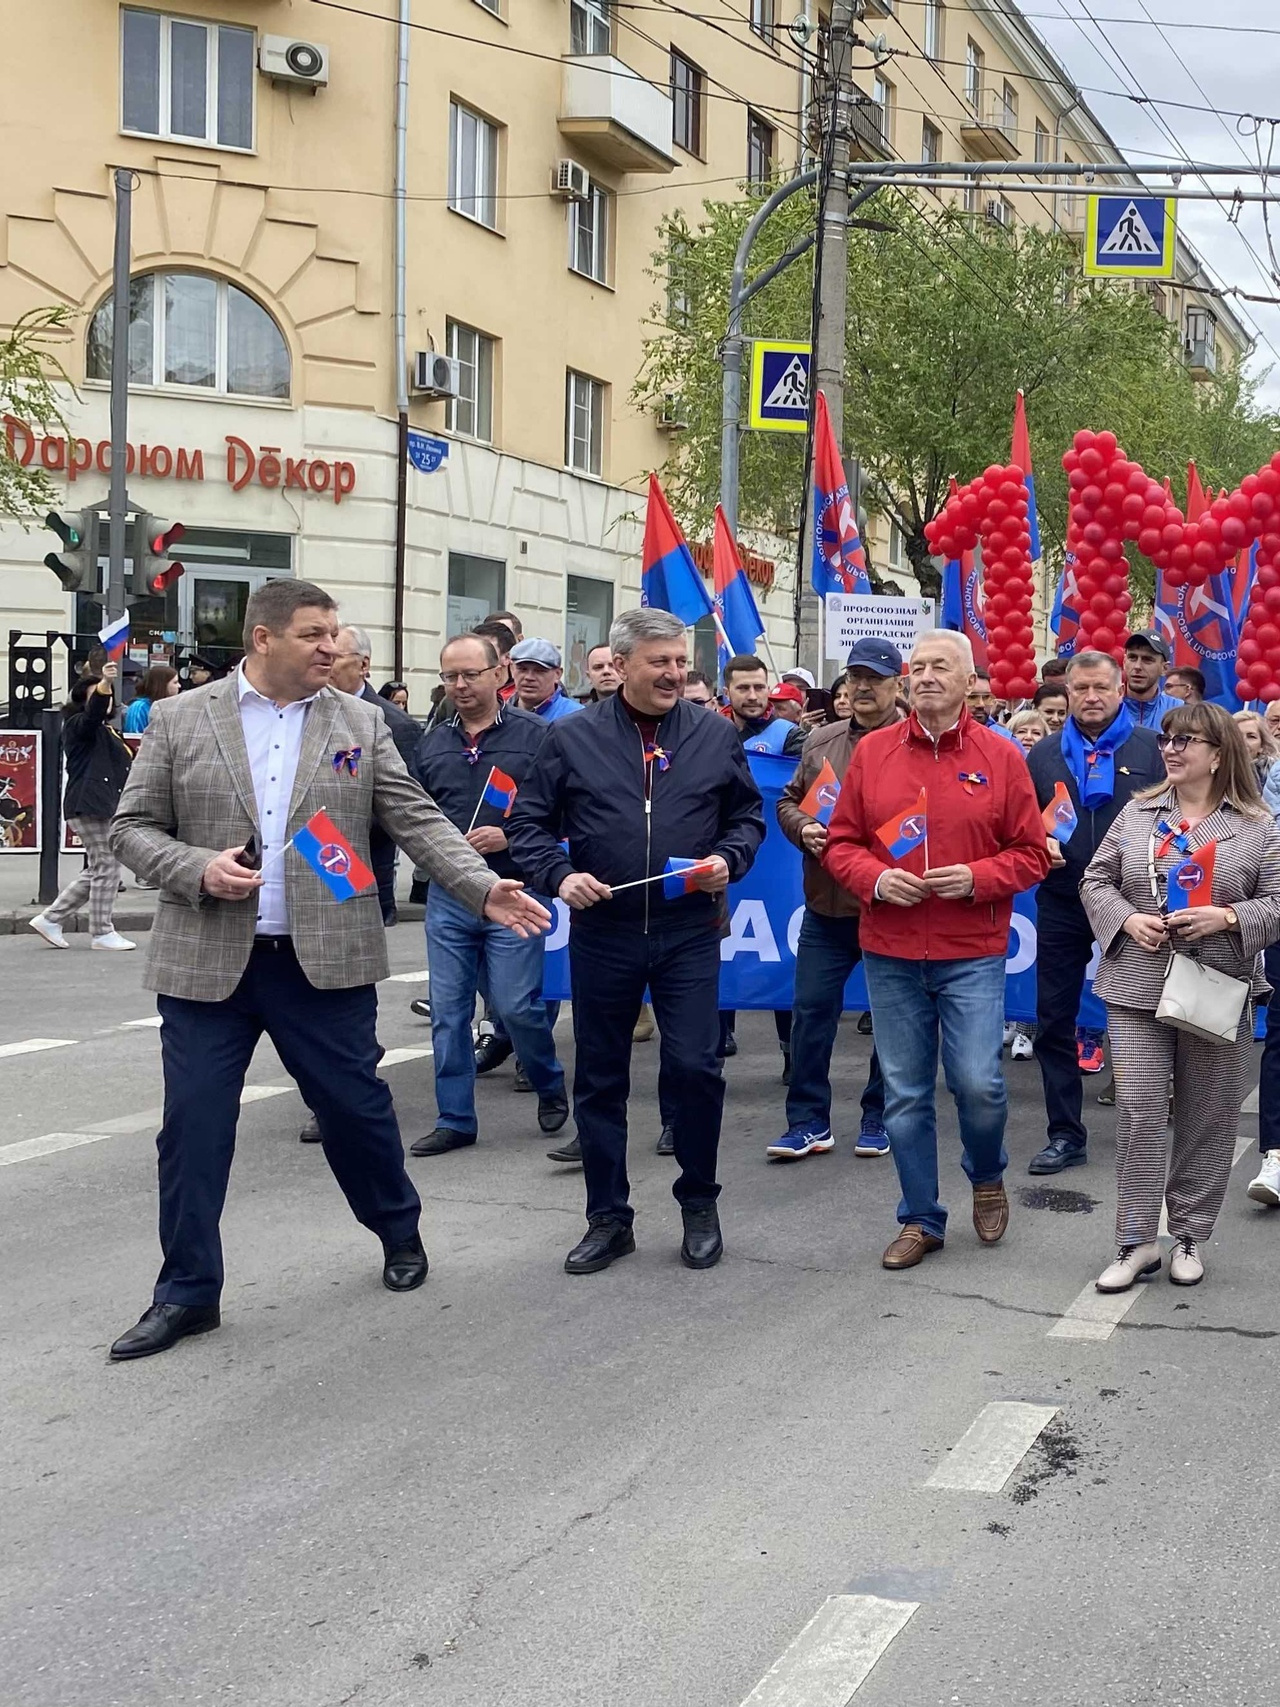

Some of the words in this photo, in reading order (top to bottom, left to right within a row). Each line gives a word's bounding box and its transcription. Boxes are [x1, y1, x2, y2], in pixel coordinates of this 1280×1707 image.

[421, 453, 431, 466] 25
[843, 605, 918, 616] ПРОФСОЮЗНАЯ
[846, 617, 914, 627] ОРГАНИЗАЦИЯ
